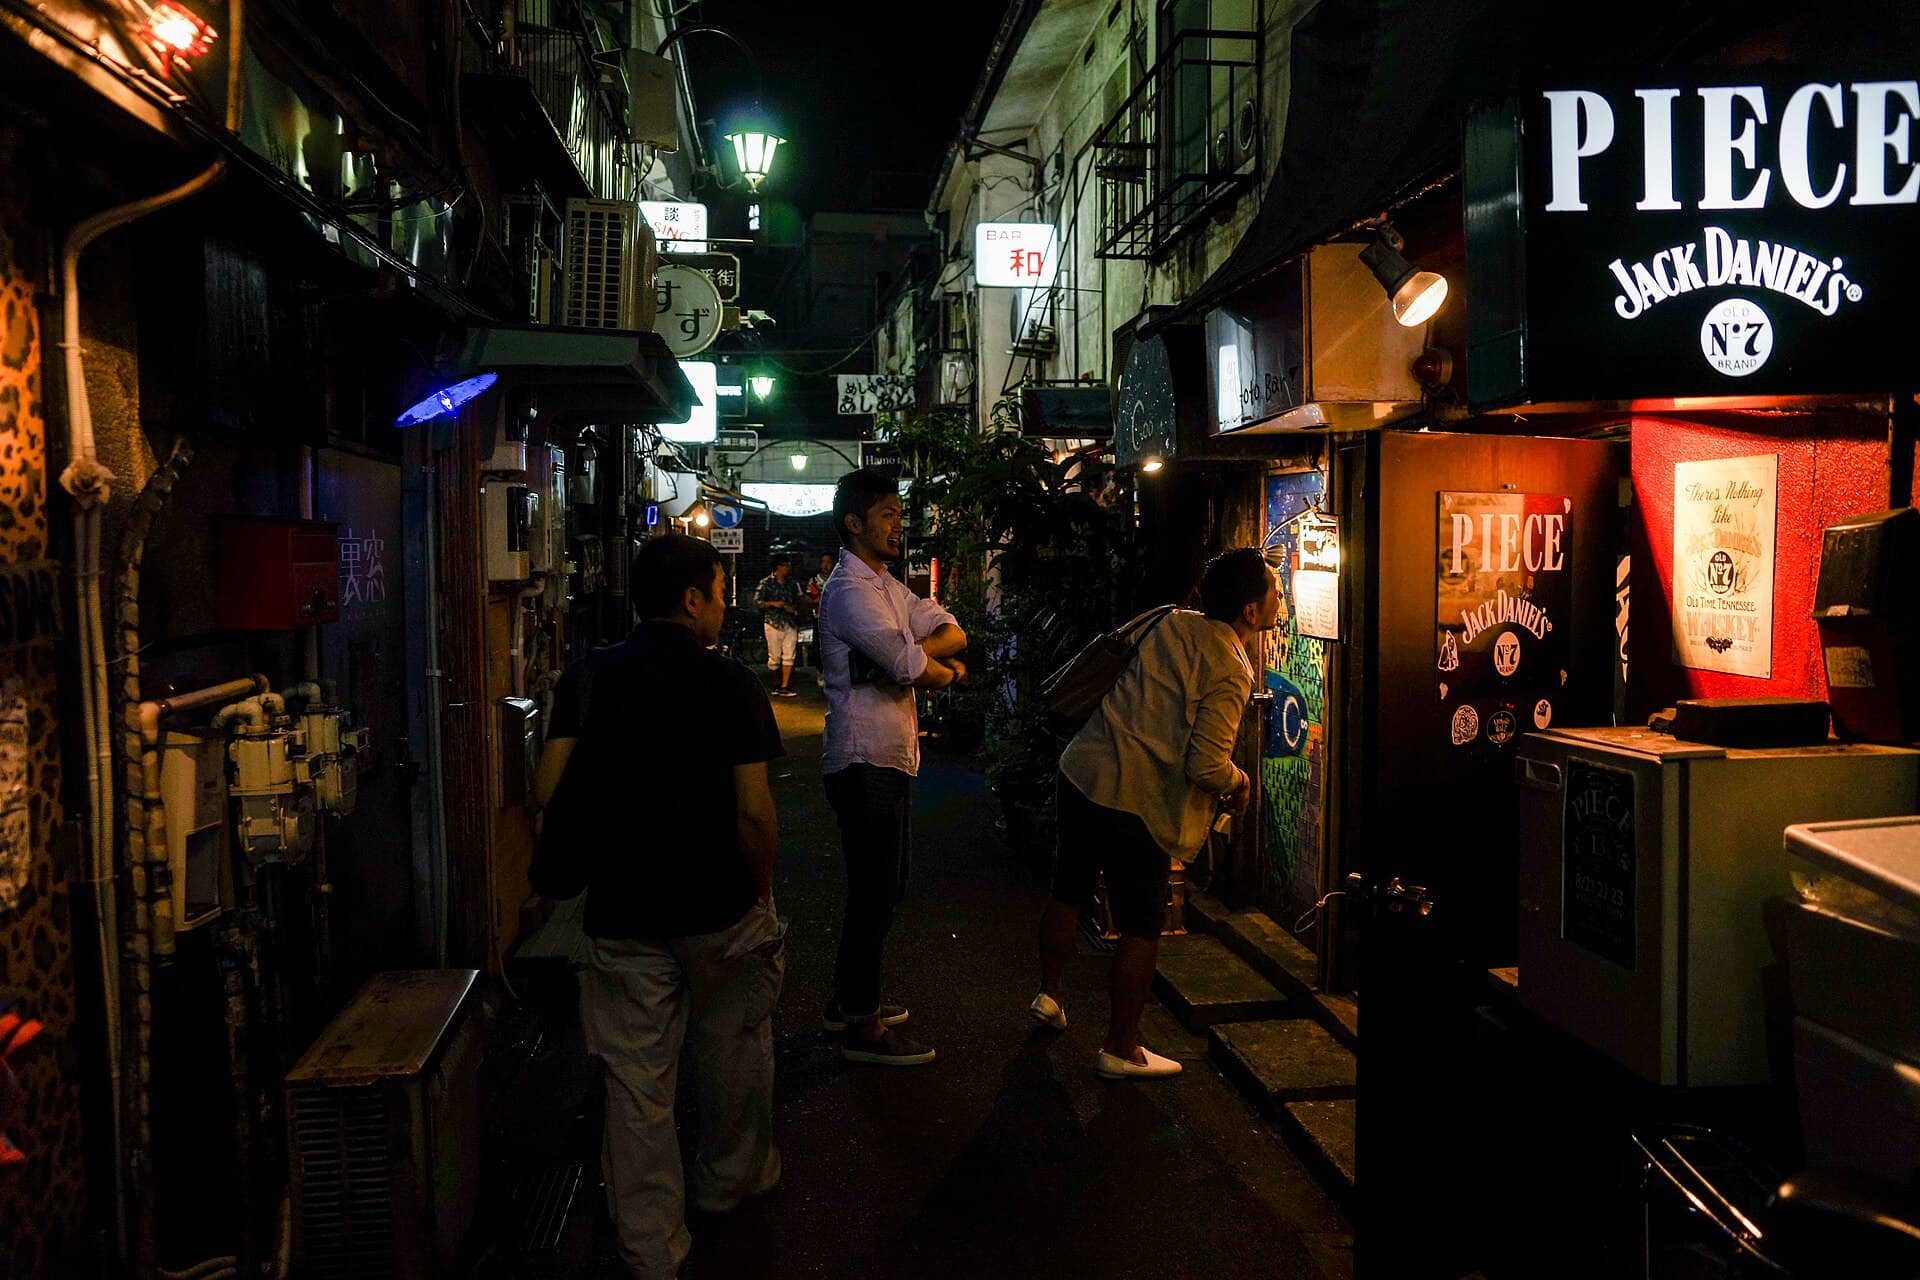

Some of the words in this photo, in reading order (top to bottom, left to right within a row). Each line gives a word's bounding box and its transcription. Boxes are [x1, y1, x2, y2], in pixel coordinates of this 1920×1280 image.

[1543, 81, 1920, 211] PIECE
[986, 230, 1022, 240] BAR
[1010, 248, 1042, 277] 和
[1608, 243, 1706, 320] JACK
[1703, 226, 1850, 317] DANIEL'S
[1722, 307, 1750, 318] OLD
[1717, 358, 1758, 371] BRAND
[1685, 482, 1721, 502] There's
[1725, 479, 1763, 508] Nothing
[1711, 503, 1732, 524] Like
[1450, 513, 1564, 574] PIECE
[1714, 554, 1727, 562] OLD
[1686, 596, 1699, 608] OLD
[1700, 596, 1717, 609] TIME
[1460, 599, 1496, 645] JACK
[1497, 589, 1549, 640] DANIEL'S
